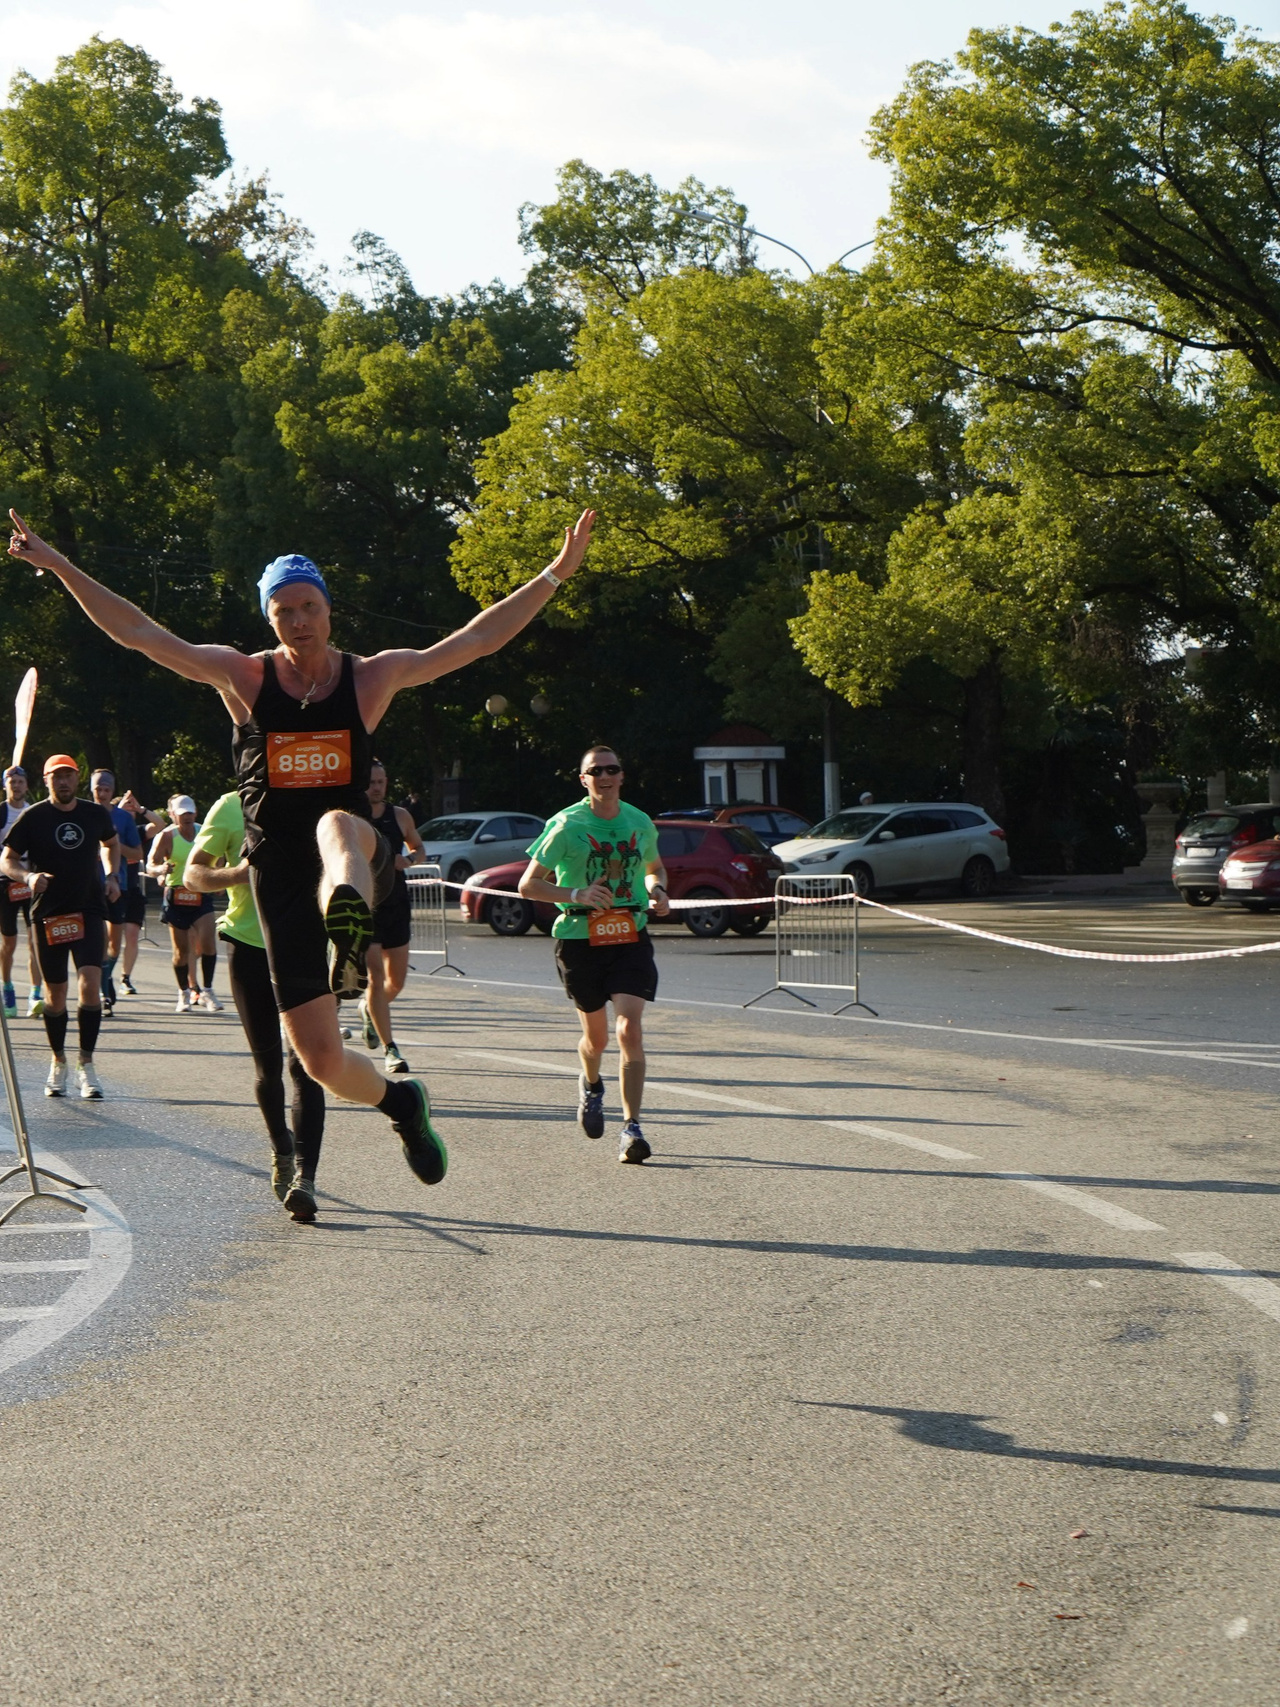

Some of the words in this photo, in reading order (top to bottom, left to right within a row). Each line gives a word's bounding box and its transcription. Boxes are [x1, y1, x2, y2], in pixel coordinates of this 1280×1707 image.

[278, 752, 340, 773] 8580
[52, 923, 79, 936] 8613
[596, 921, 630, 936] 8013
